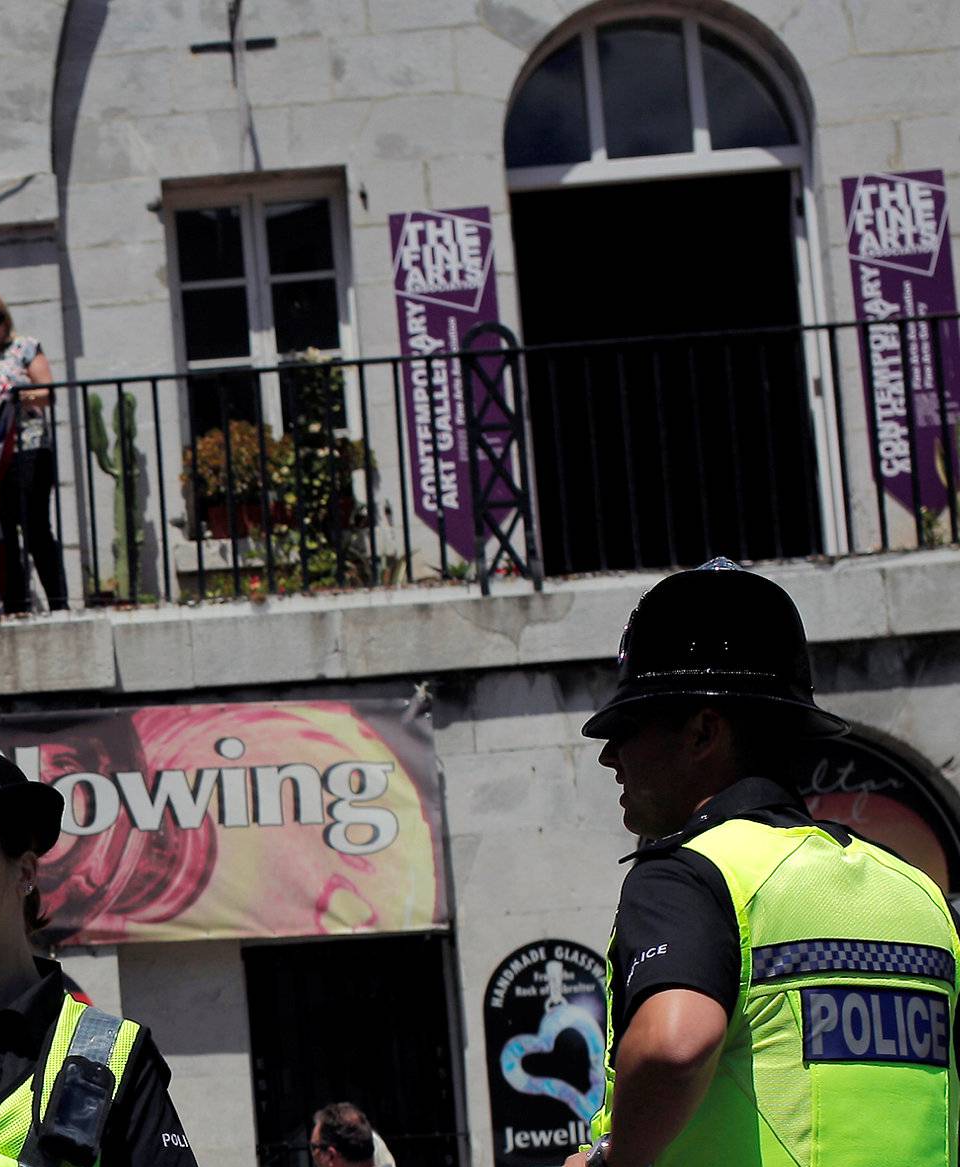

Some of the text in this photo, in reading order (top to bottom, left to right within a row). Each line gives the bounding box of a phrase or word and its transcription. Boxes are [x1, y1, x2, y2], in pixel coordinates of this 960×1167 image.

[860, 182, 934, 214] THE
[406, 218, 480, 247] THE
[855, 206, 937, 234] FINE
[401, 242, 482, 270] FINE
[858, 230, 938, 258] ARTS
[404, 264, 482, 293] ARTS
[491, 947, 546, 1008] HANDMADE
[810, 992, 947, 1061] POLICE
[504, 1121, 592, 1154] Jewell
